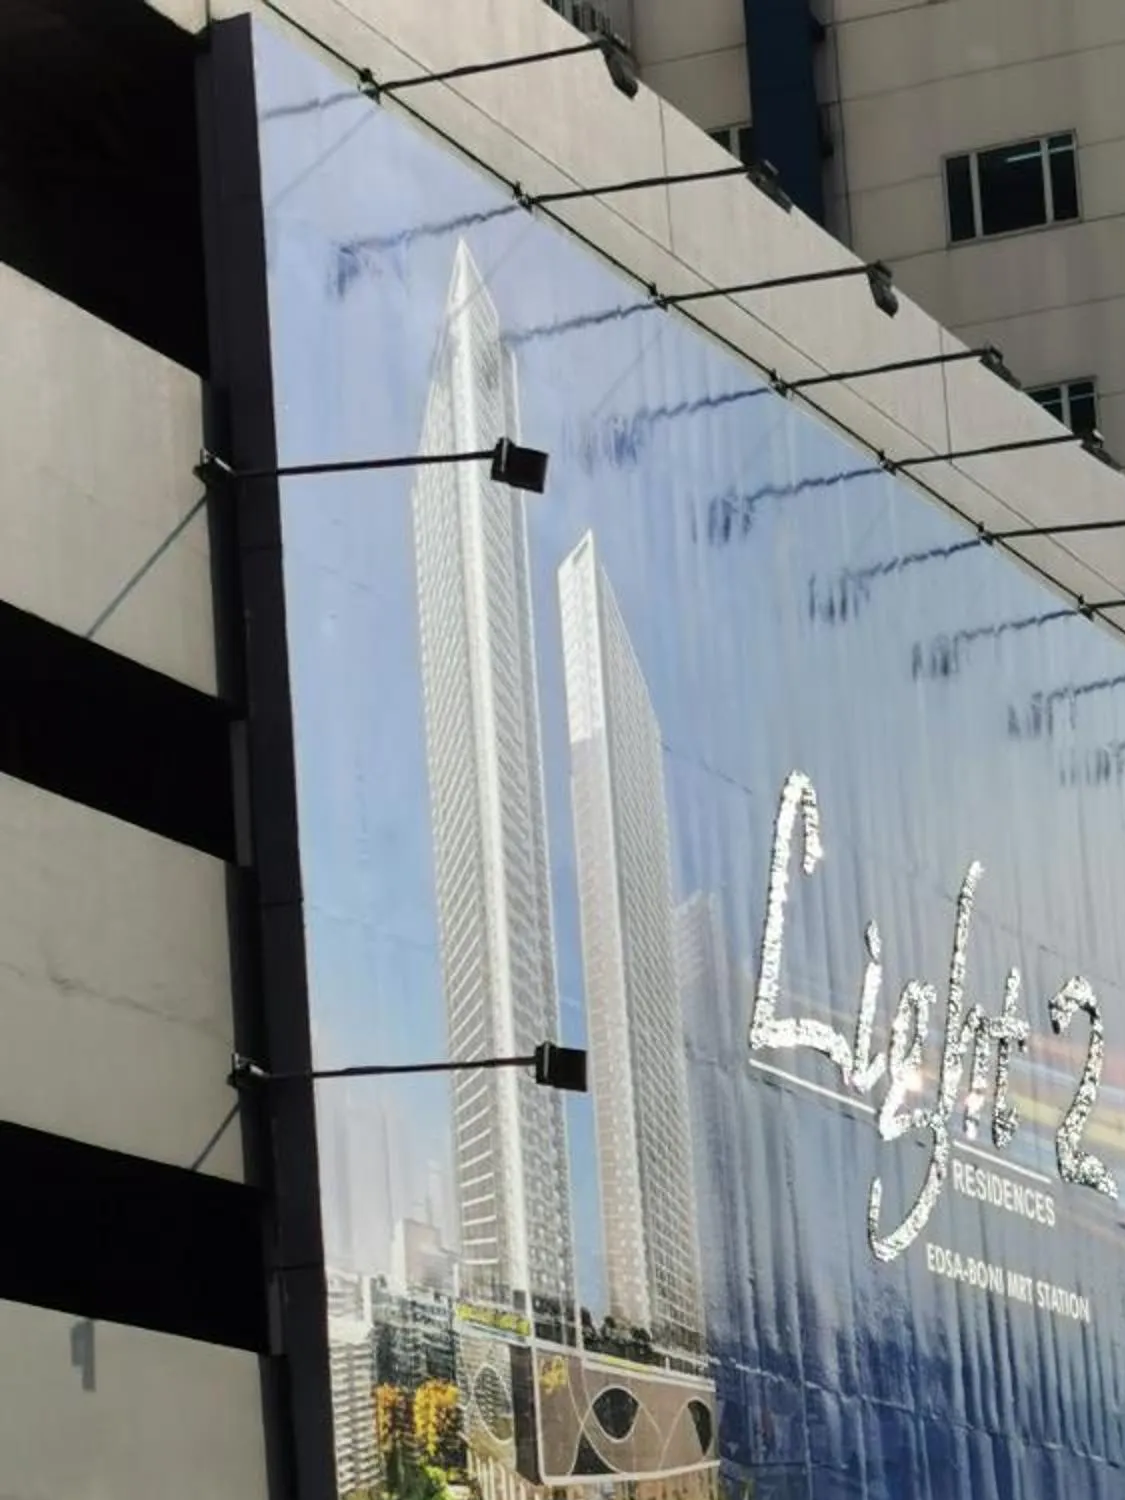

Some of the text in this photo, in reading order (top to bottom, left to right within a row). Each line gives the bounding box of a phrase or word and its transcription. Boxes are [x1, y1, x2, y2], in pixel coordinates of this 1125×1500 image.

[750, 768, 1119, 1262] Light 2
[952, 1158, 1057, 1228] RESIDENCES
[926, 1242, 1091, 1324] EDSA-BONI MRT STATION
